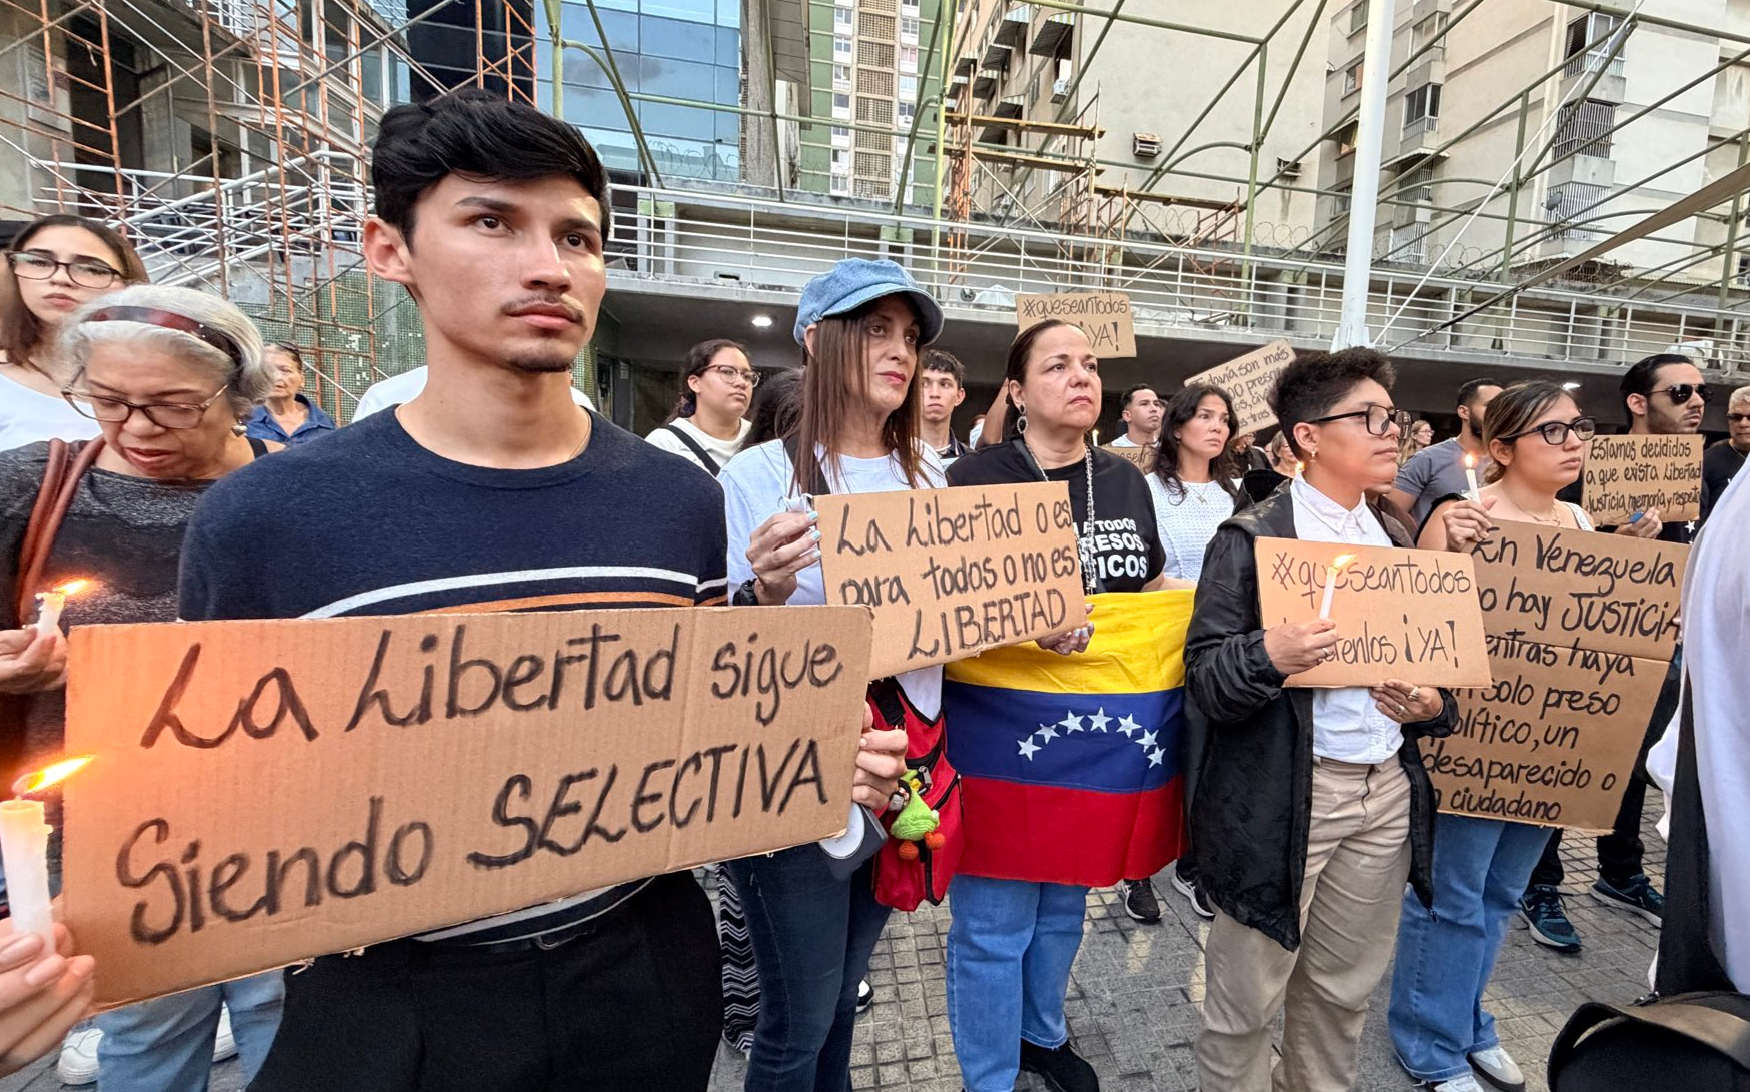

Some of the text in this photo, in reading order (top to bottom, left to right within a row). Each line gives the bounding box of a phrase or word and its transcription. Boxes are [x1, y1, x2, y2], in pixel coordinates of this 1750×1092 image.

[1239, 360, 1260, 377] son
[1264, 346, 1290, 366] más
[1641, 437, 1691, 459] decididos
[1586, 469, 1596, 485] a
[1599, 467, 1619, 492] que
[1624, 462, 1659, 482] exista
[837, 503, 892, 556] La
[1036, 502, 1048, 534] o
[1052, 499, 1072, 530] es
[1094, 518, 1137, 532] TODOS
[920, 554, 998, 600] todos
[1003, 554, 1017, 586] o
[1022, 552, 1048, 583] no
[1051, 545, 1076, 579] es
[1536, 532, 1676, 597] Venezuela
[907, 588, 1066, 661] LIBERTAD
[1505, 576, 1552, 631] hay
[1567, 637, 1635, 686] haya
[140, 641, 320, 751] La
[710, 630, 844, 727] sigue
[1539, 686, 1621, 720] preso
[1421, 740, 1616, 791] desaparecido o
[467, 737, 829, 870] SELECTIVA
[1450, 787, 1563, 821] ciudadano
